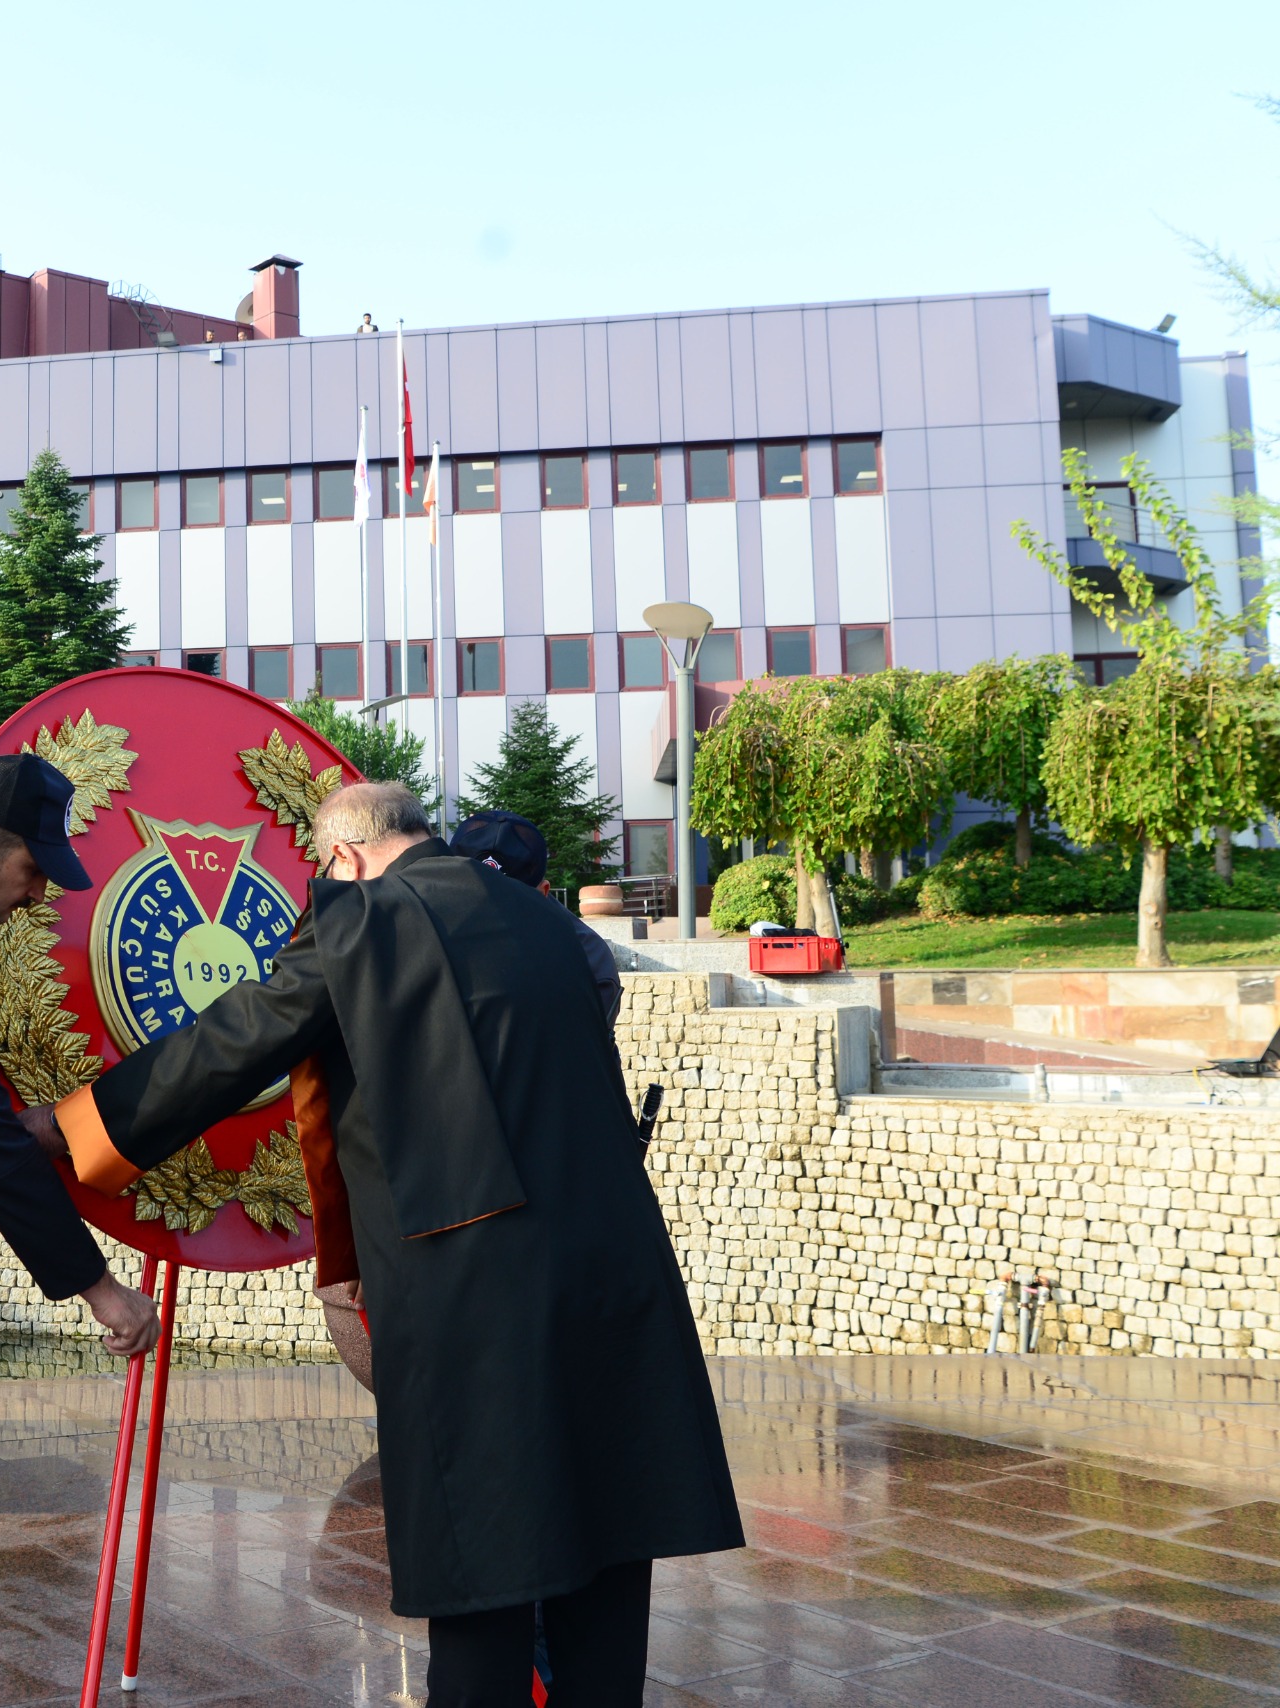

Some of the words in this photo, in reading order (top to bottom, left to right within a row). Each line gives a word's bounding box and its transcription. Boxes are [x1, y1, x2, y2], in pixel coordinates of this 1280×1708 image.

[186, 849, 226, 872] T.C.
[120, 878, 173, 983] SÜTÇÜ
[183, 961, 247, 984] 1992
